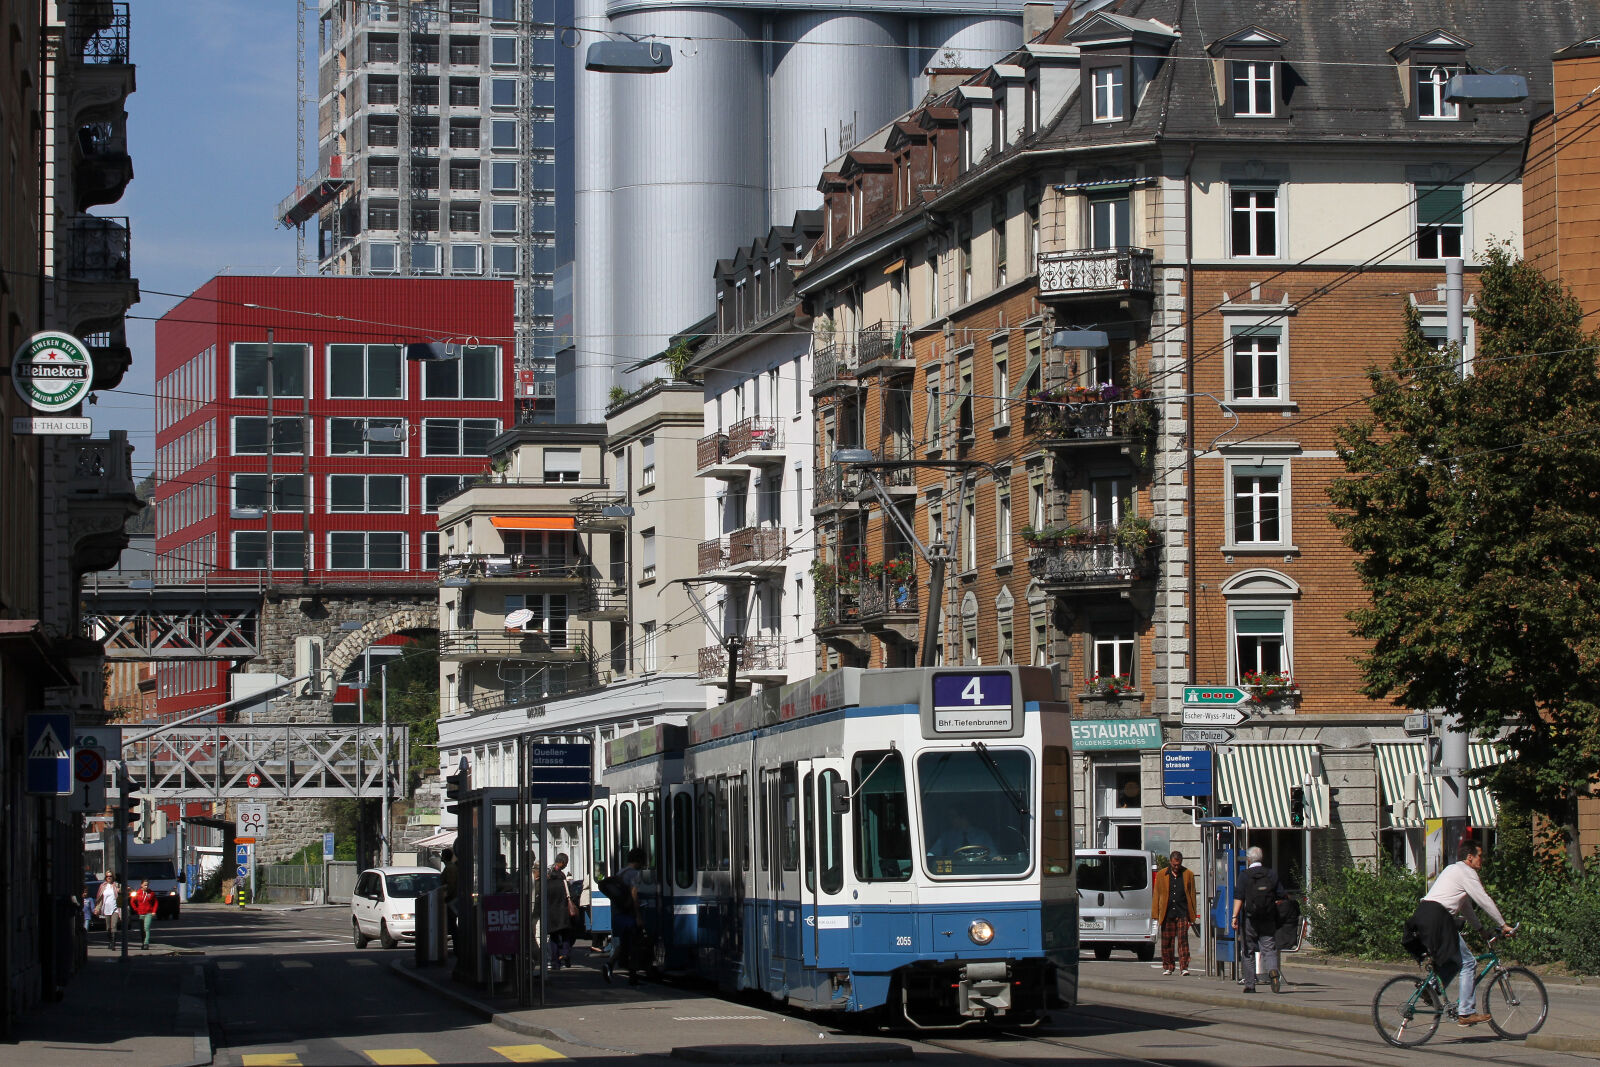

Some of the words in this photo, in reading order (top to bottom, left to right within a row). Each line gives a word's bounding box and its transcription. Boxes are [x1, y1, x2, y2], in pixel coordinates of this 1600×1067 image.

[28, 340, 60, 355] EINEKEN
[62, 343, 77, 356] BEER
[22, 365, 83, 377] Heineken
[54, 385, 79, 402] QUALITY
[65, 422, 89, 430] CLUB
[961, 676, 985, 705] 4
[1184, 712, 1236, 721] Escher-Wyss-Platz
[938, 719, 954, 727] Bhf.
[955, 719, 1008, 727] Tiefenbrunnen
[1071, 722, 1157, 739] ESTAURANT
[1200, 731, 1223, 740] Polizei
[534, 748, 568, 756] Quellen-
[896, 936, 912, 946] 2055
